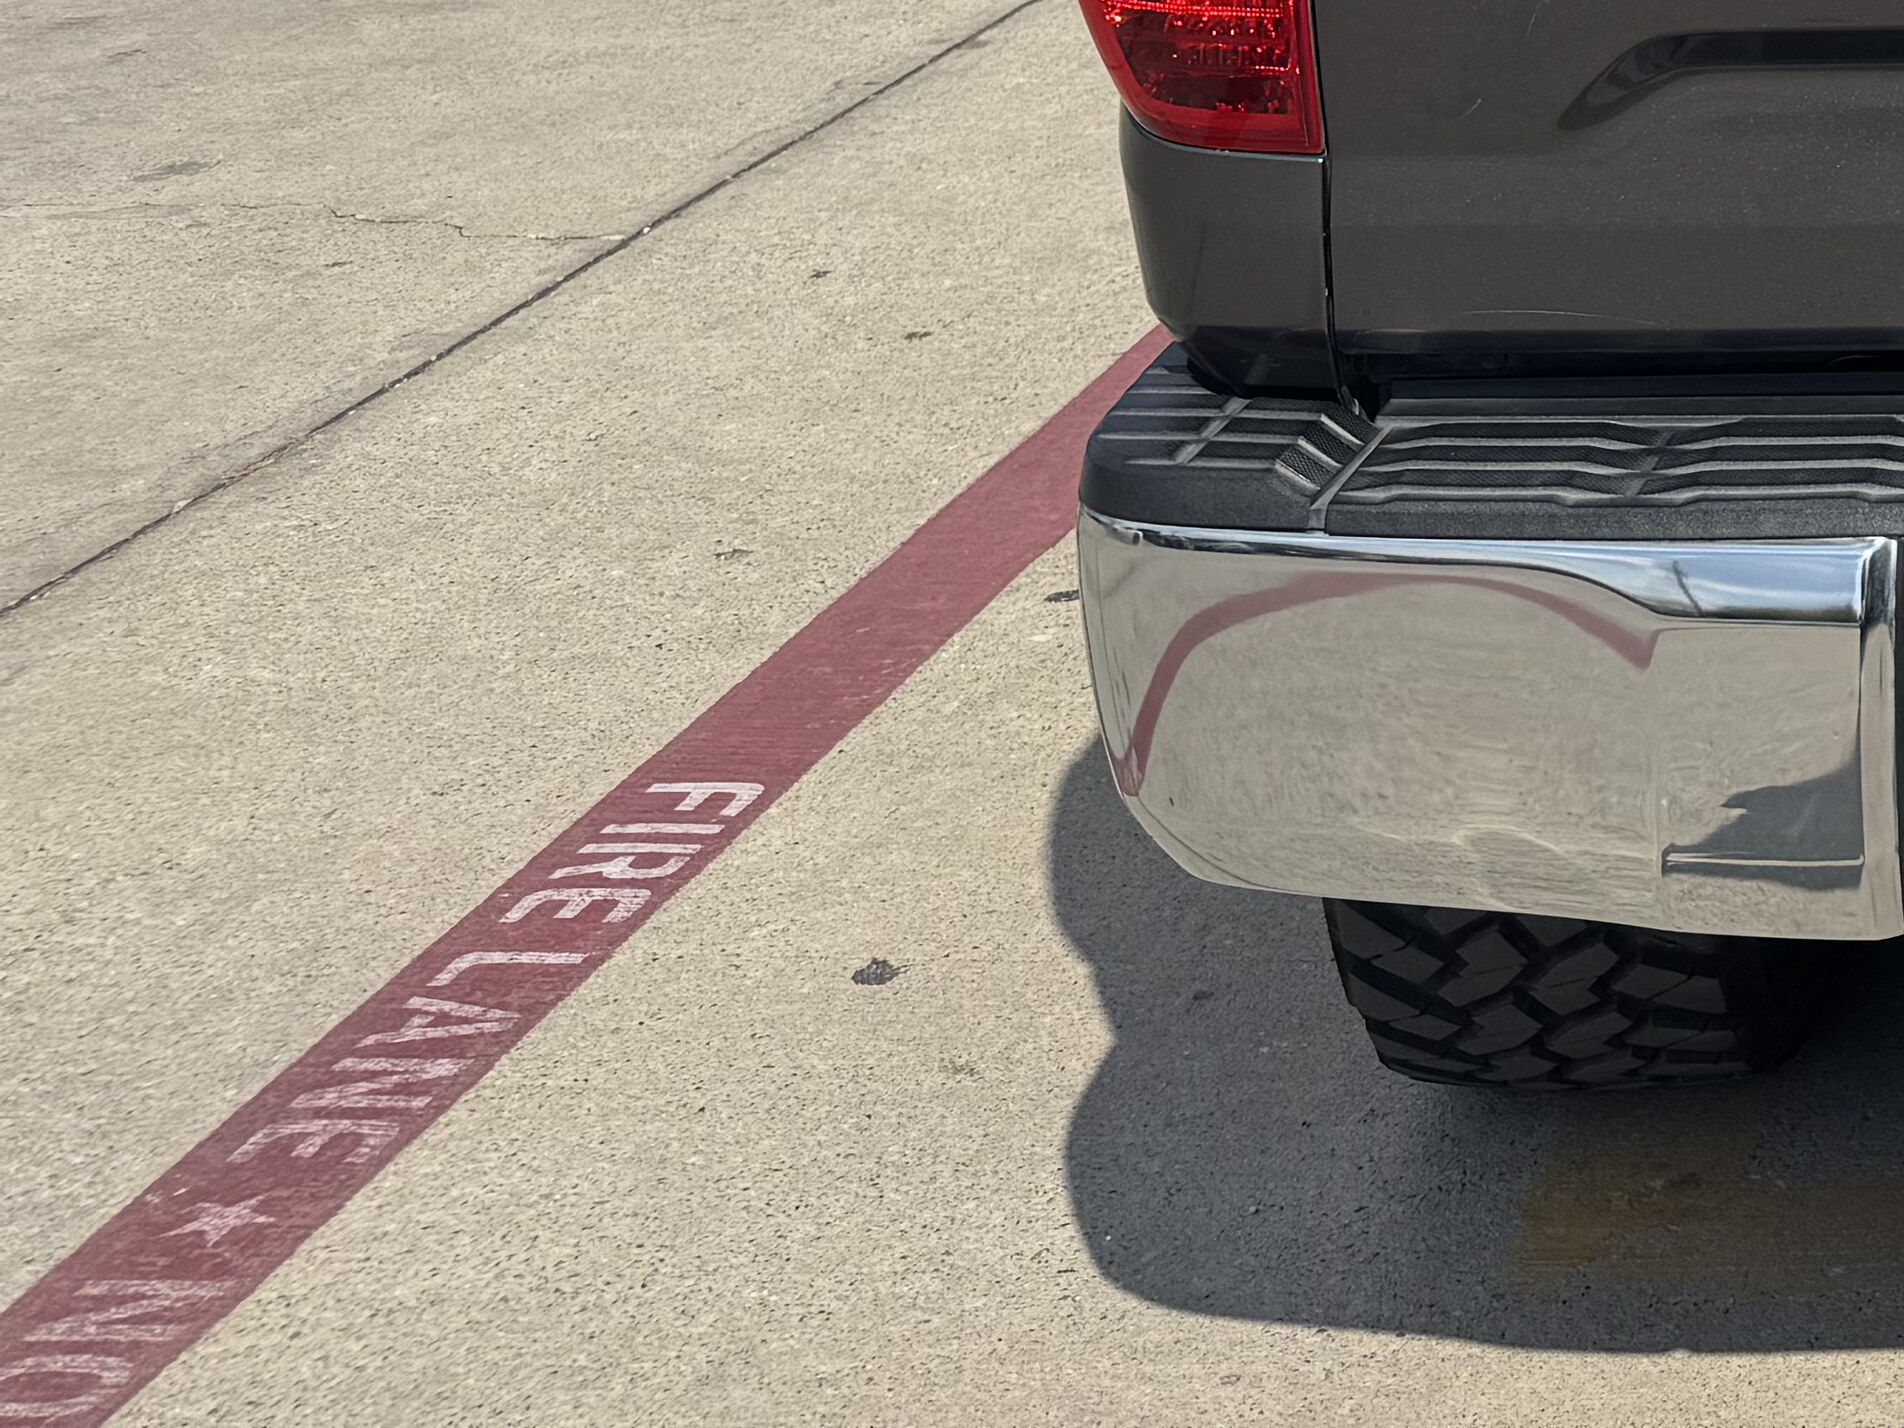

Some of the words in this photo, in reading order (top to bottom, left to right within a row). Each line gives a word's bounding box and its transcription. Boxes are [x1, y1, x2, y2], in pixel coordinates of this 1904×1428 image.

[500, 781, 764, 925] FIRE
[227, 950, 588, 1164] LANE
[0, 1278, 232, 1420] NO
